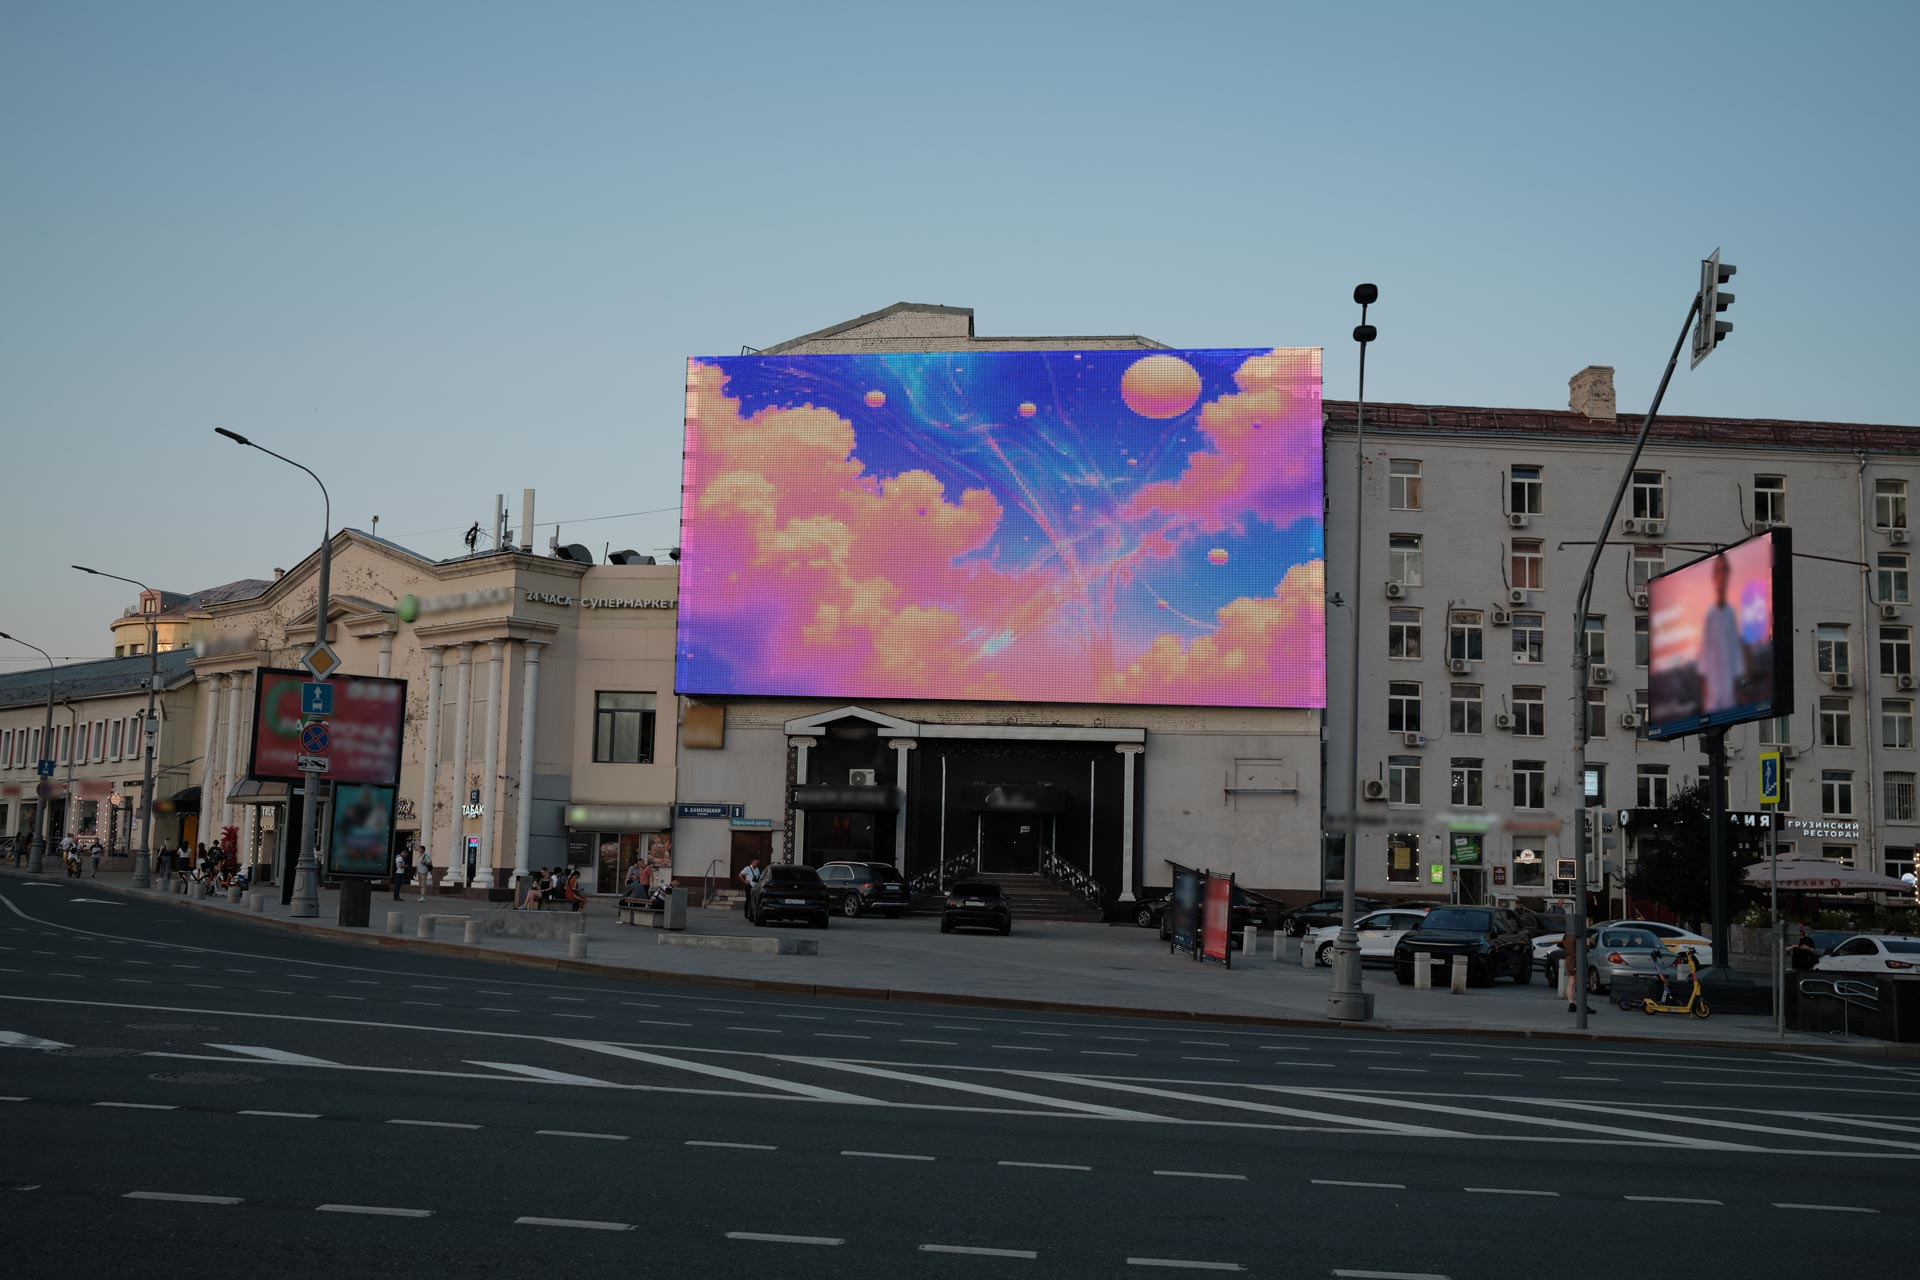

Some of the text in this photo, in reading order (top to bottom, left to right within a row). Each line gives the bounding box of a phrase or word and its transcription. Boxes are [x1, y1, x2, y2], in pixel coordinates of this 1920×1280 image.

[526, 591, 573, 606] 24 ЧАСА
[580, 598, 676, 610] СУПЕРМАРКЕТ
[462, 804, 484, 816] ТАБАК
[735, 808, 740, 817] 1
[1788, 820, 1859, 830] ГРУЗИНСКИЙ
[1803, 830, 1859, 838] РЕСТОРАН
